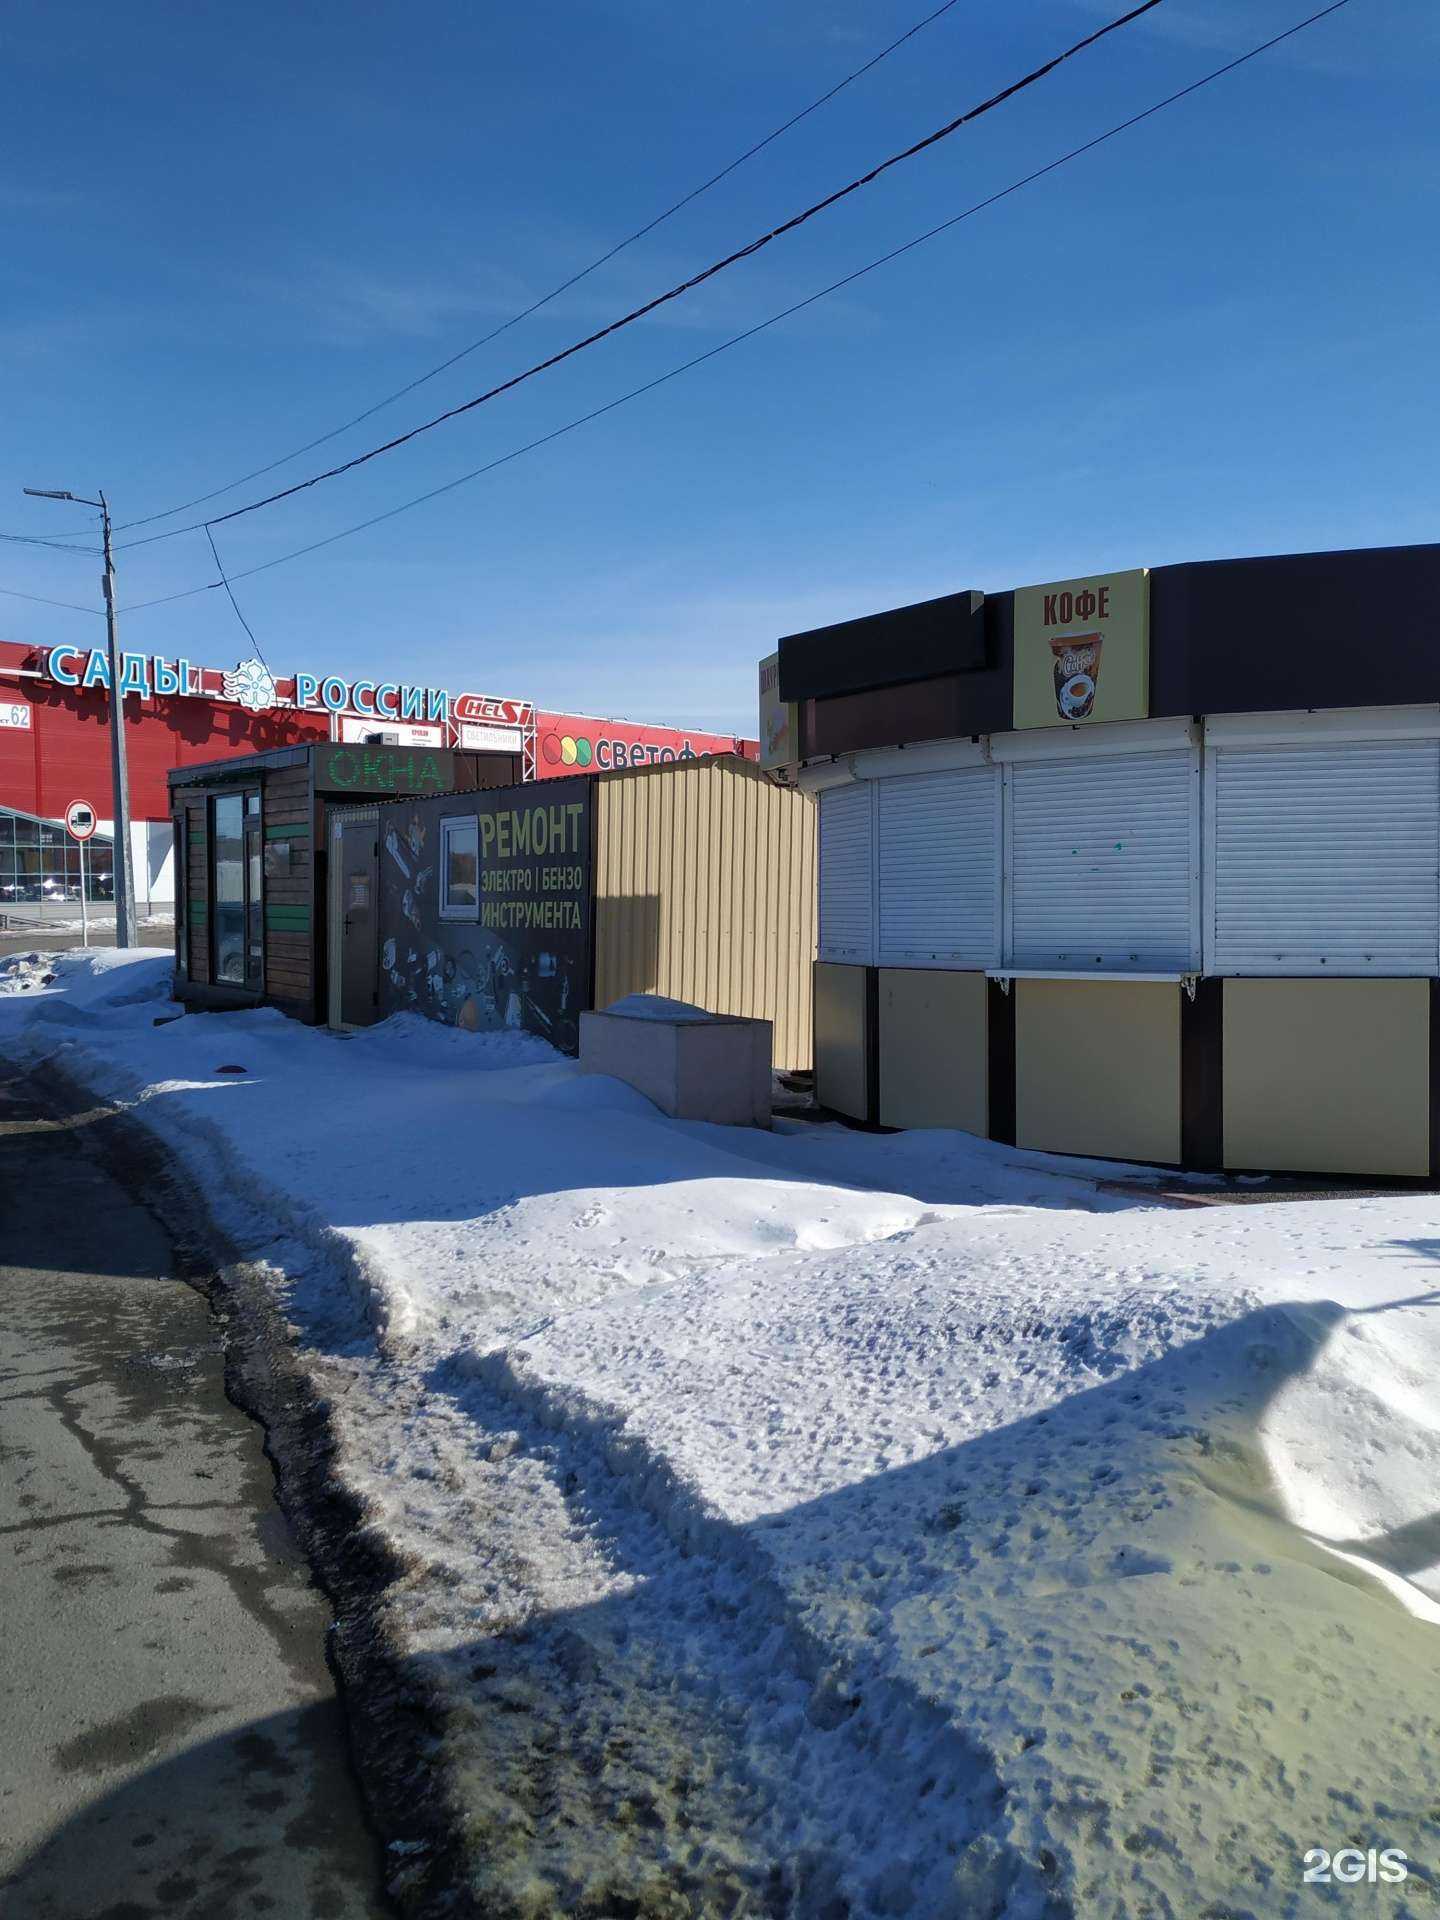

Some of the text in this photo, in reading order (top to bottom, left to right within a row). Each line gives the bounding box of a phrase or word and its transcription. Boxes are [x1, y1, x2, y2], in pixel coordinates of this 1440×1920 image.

[1043, 586, 1110, 626] КОФЕ
[49, 645, 449, 723] САДЫ РОССИИ
[11, 706, 28, 726] 62
[329, 751, 444, 790] ОКНА
[479, 803, 583, 858] РЕМОНТ
[481, 866, 582, 892] ЭЛЕКТРО БЕНЗО
[481, 901, 581, 929] ИНСТРУМЕНТА
